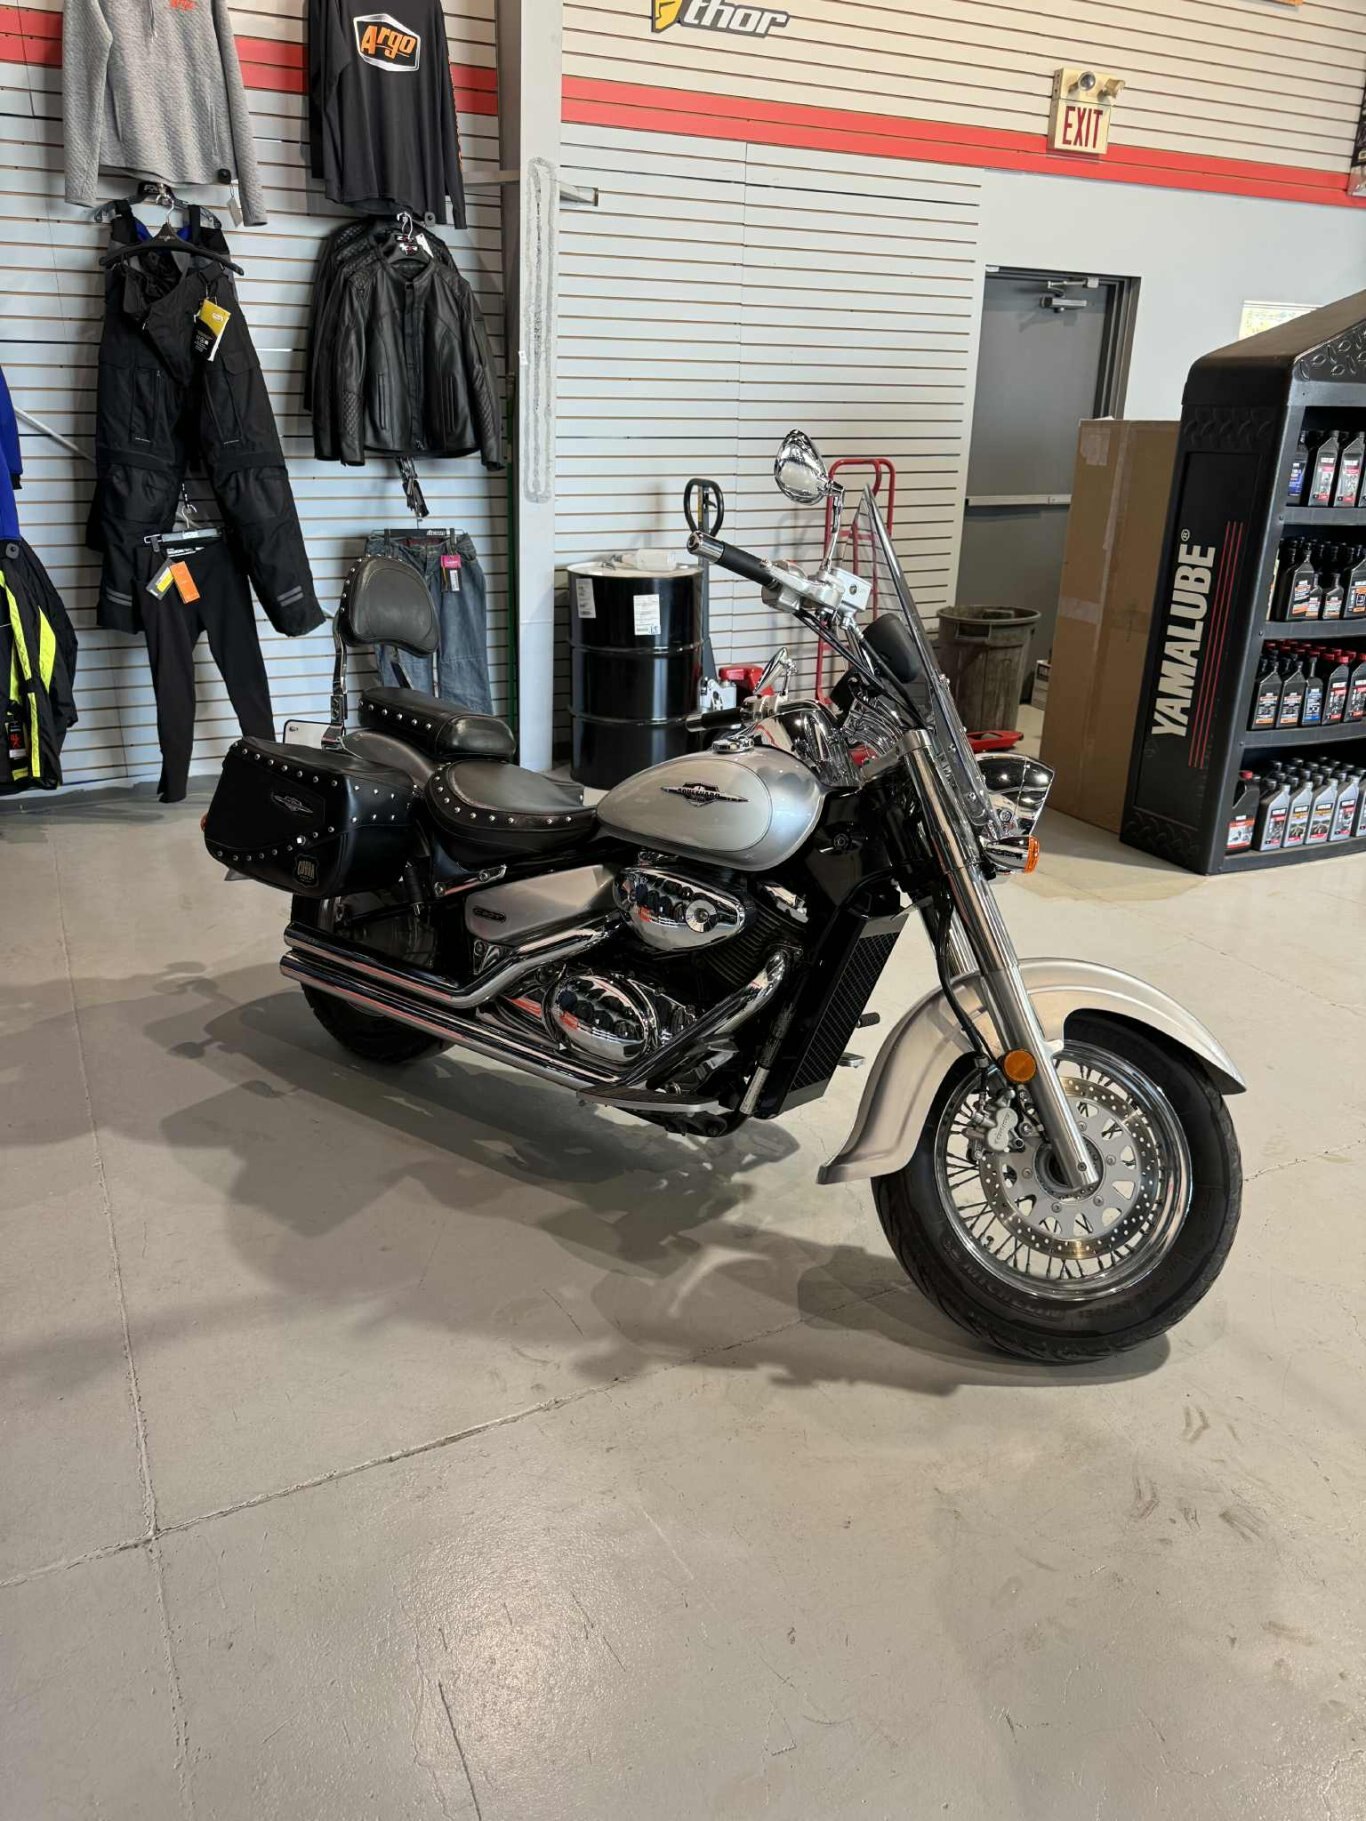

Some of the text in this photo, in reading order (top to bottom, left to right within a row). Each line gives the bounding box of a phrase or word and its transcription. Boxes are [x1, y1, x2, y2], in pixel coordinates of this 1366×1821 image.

[683, 0, 788, 34] thor
[361, 24, 417, 59] Argo
[1062, 106, 1103, 149] EXIT
